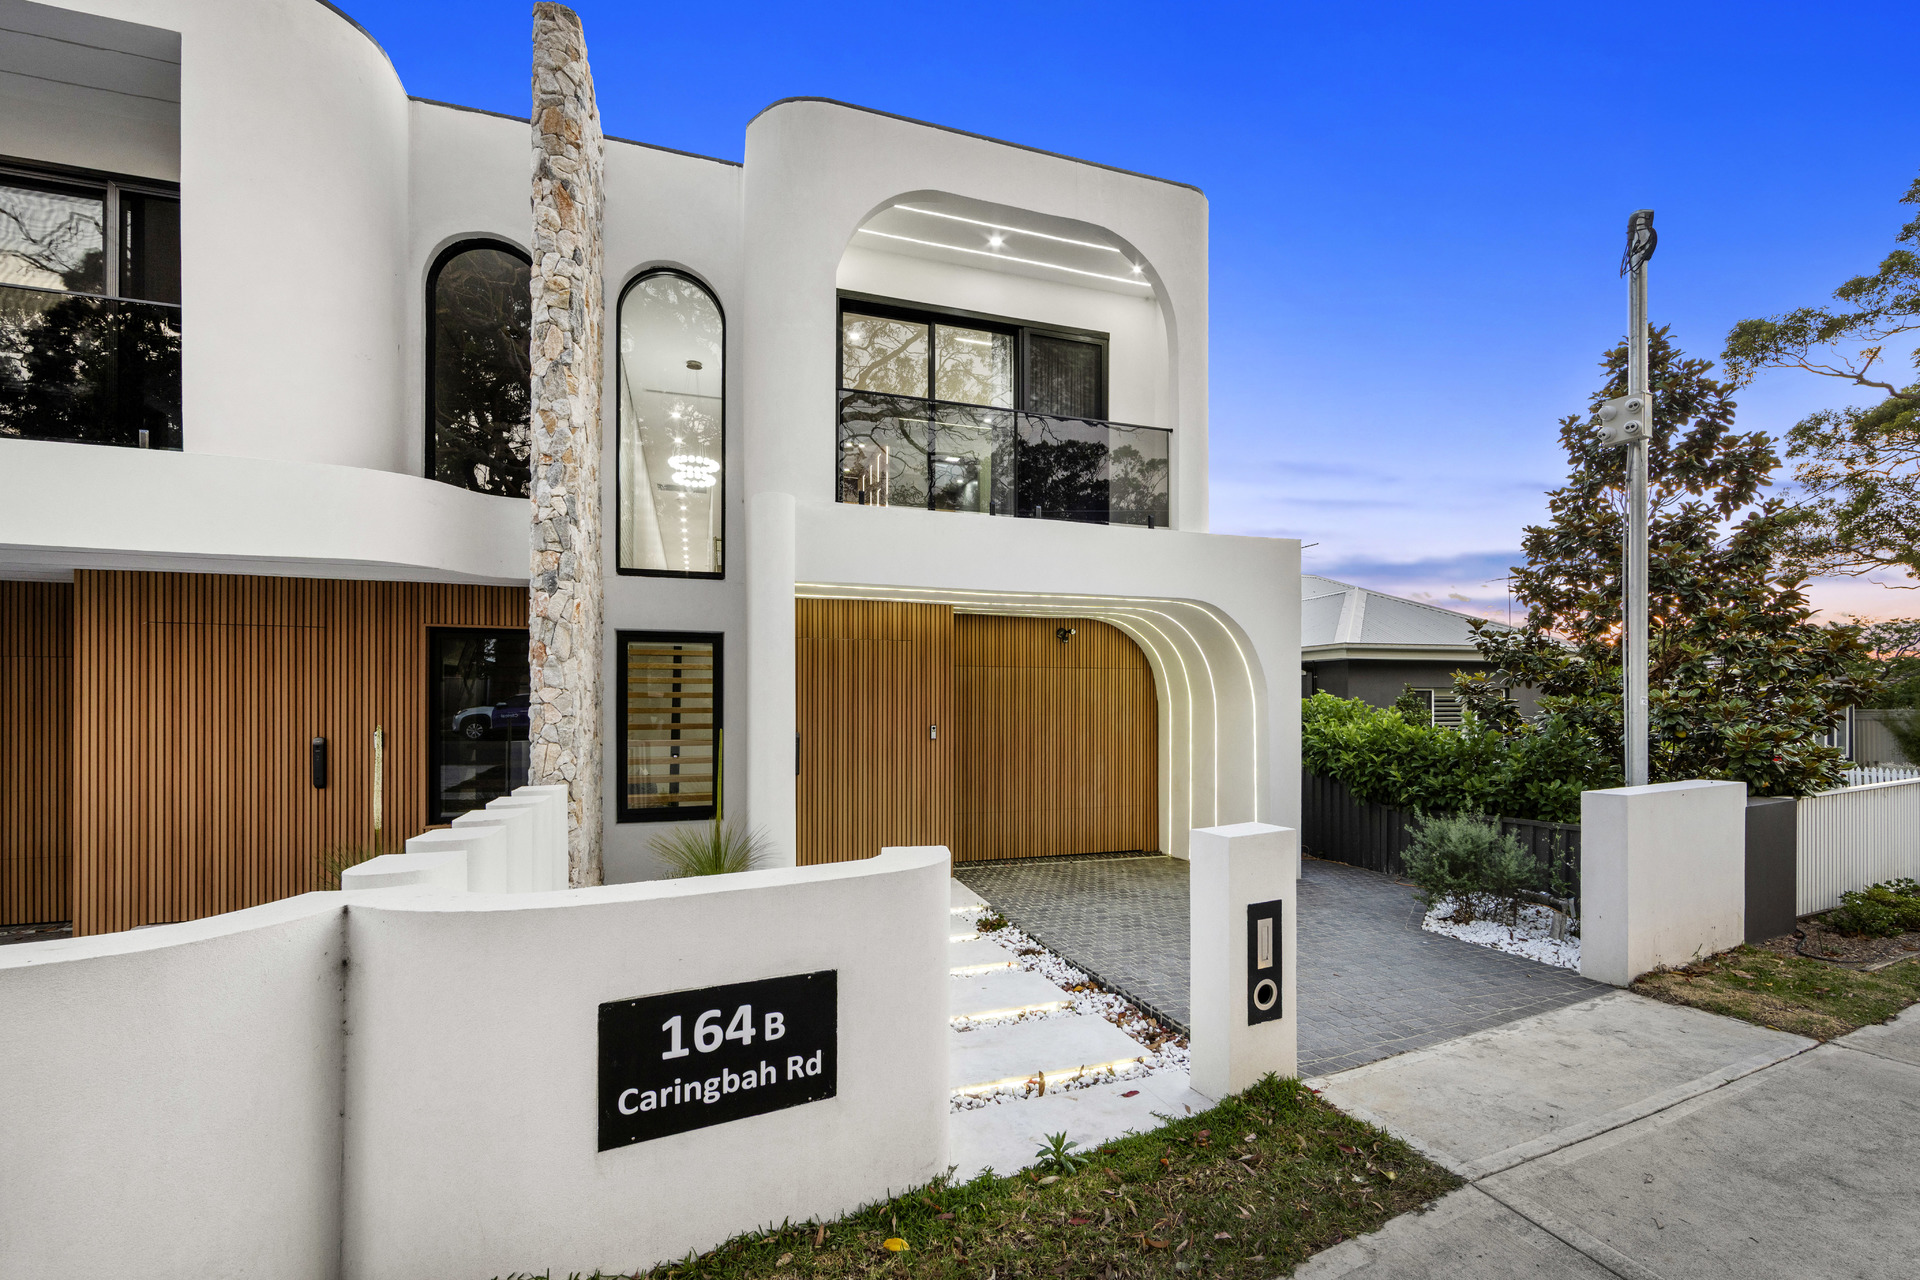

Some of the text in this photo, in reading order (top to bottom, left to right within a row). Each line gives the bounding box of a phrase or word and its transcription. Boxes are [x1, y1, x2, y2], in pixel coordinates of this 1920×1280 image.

[661, 1004, 786, 1061] 164 B
[618, 1049, 822, 1116] Caringbah Rd
